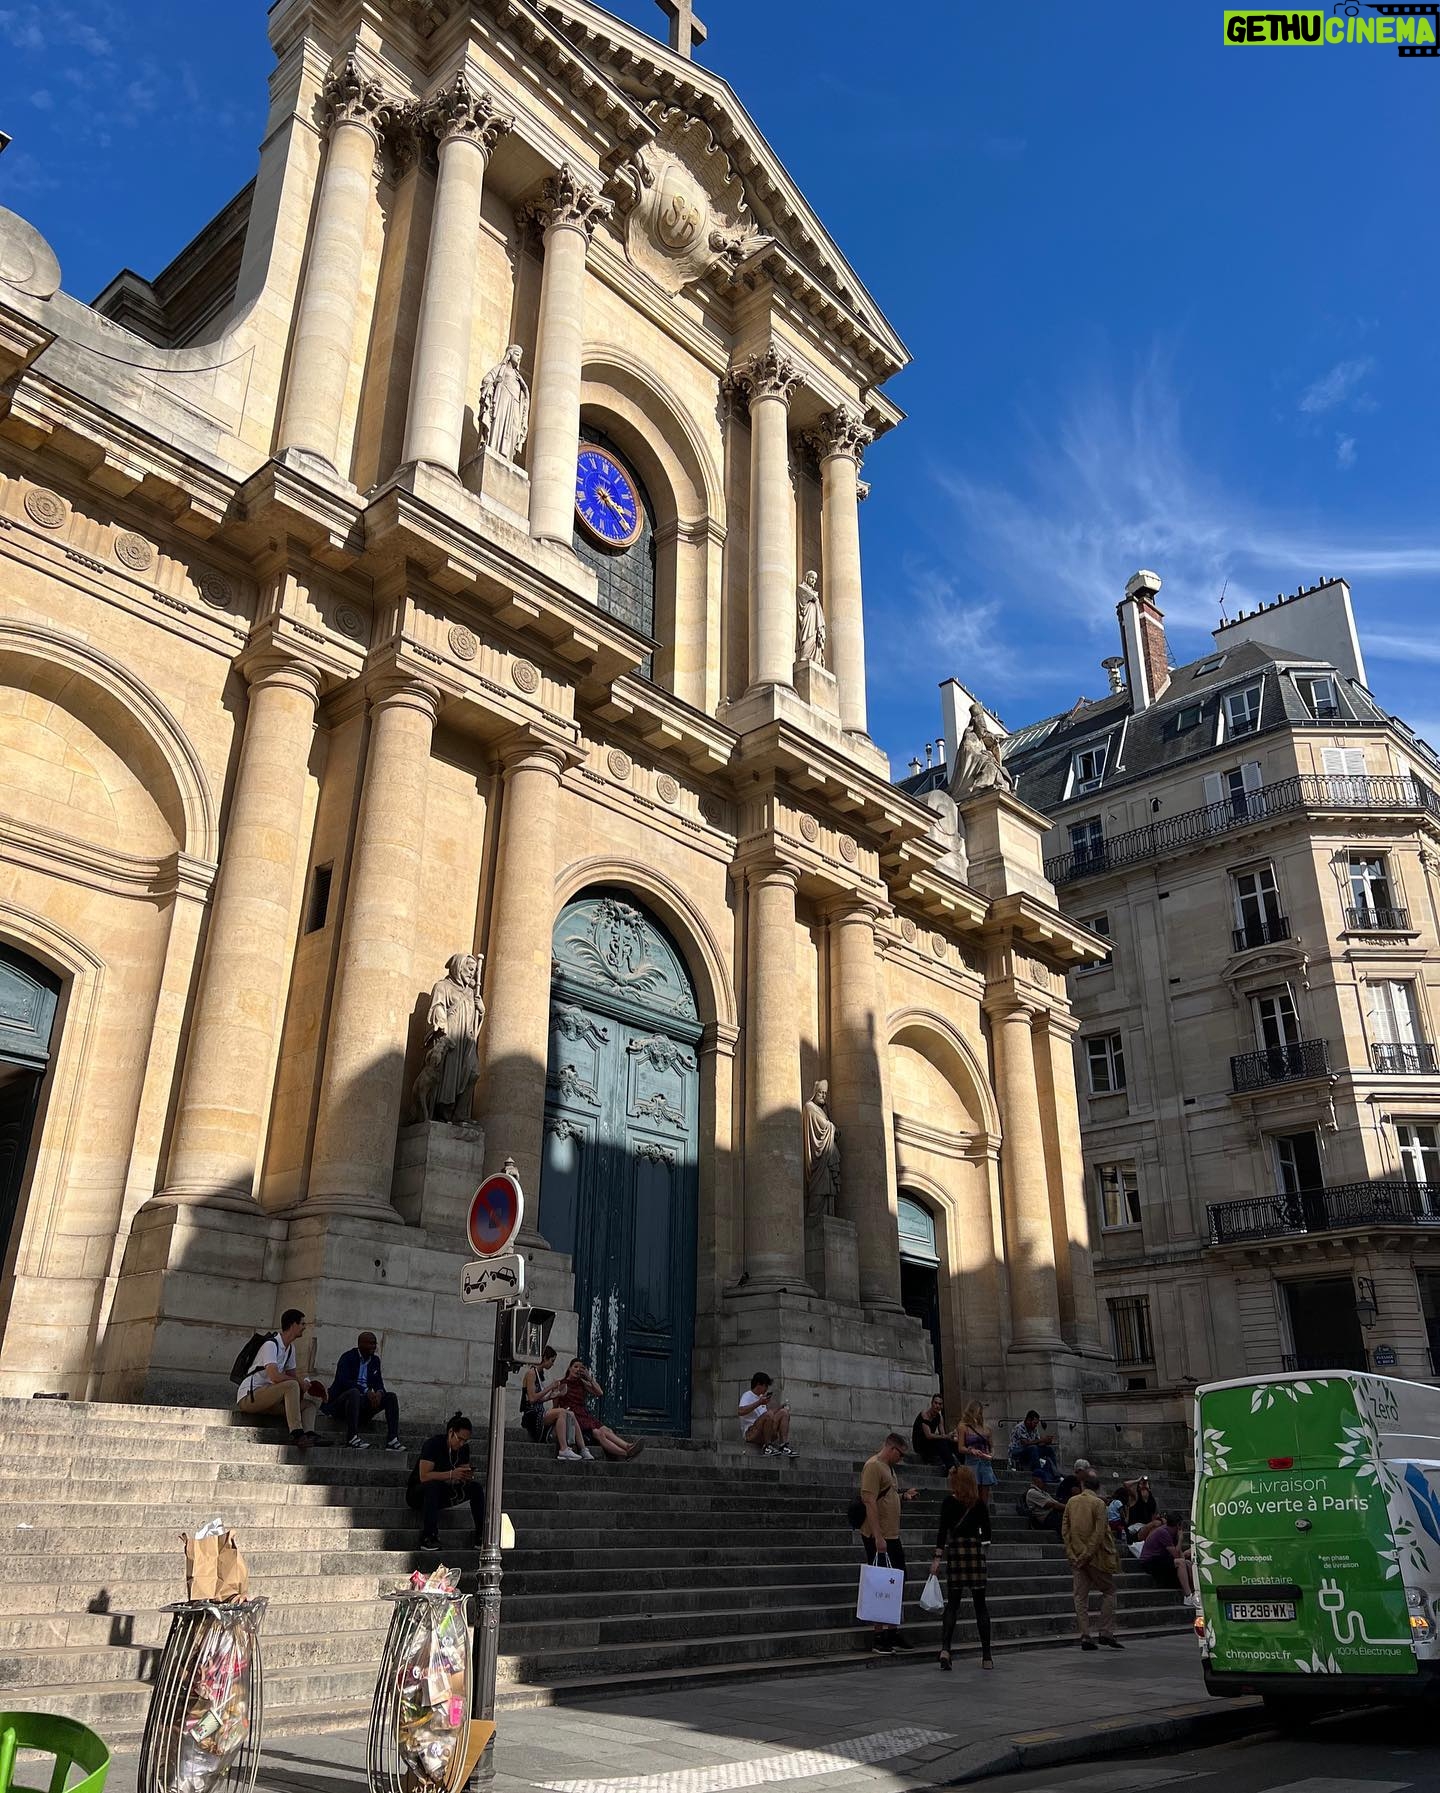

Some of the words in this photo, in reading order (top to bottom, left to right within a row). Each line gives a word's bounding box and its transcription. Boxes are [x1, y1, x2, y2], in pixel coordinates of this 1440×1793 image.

[1370, 1397, 1399, 1421] Zero
[1249, 1477, 1328, 1494] Livraison
[1209, 1500, 1253, 1517] 100%
[1256, 1498, 1303, 1513] verte
[1307, 1495, 1318, 1511] à
[1238, 1554, 1273, 1562] chronopost
[1240, 1575, 1293, 1585] Prestataire
[1225, 1649, 1292, 1660] chronopost.fr
